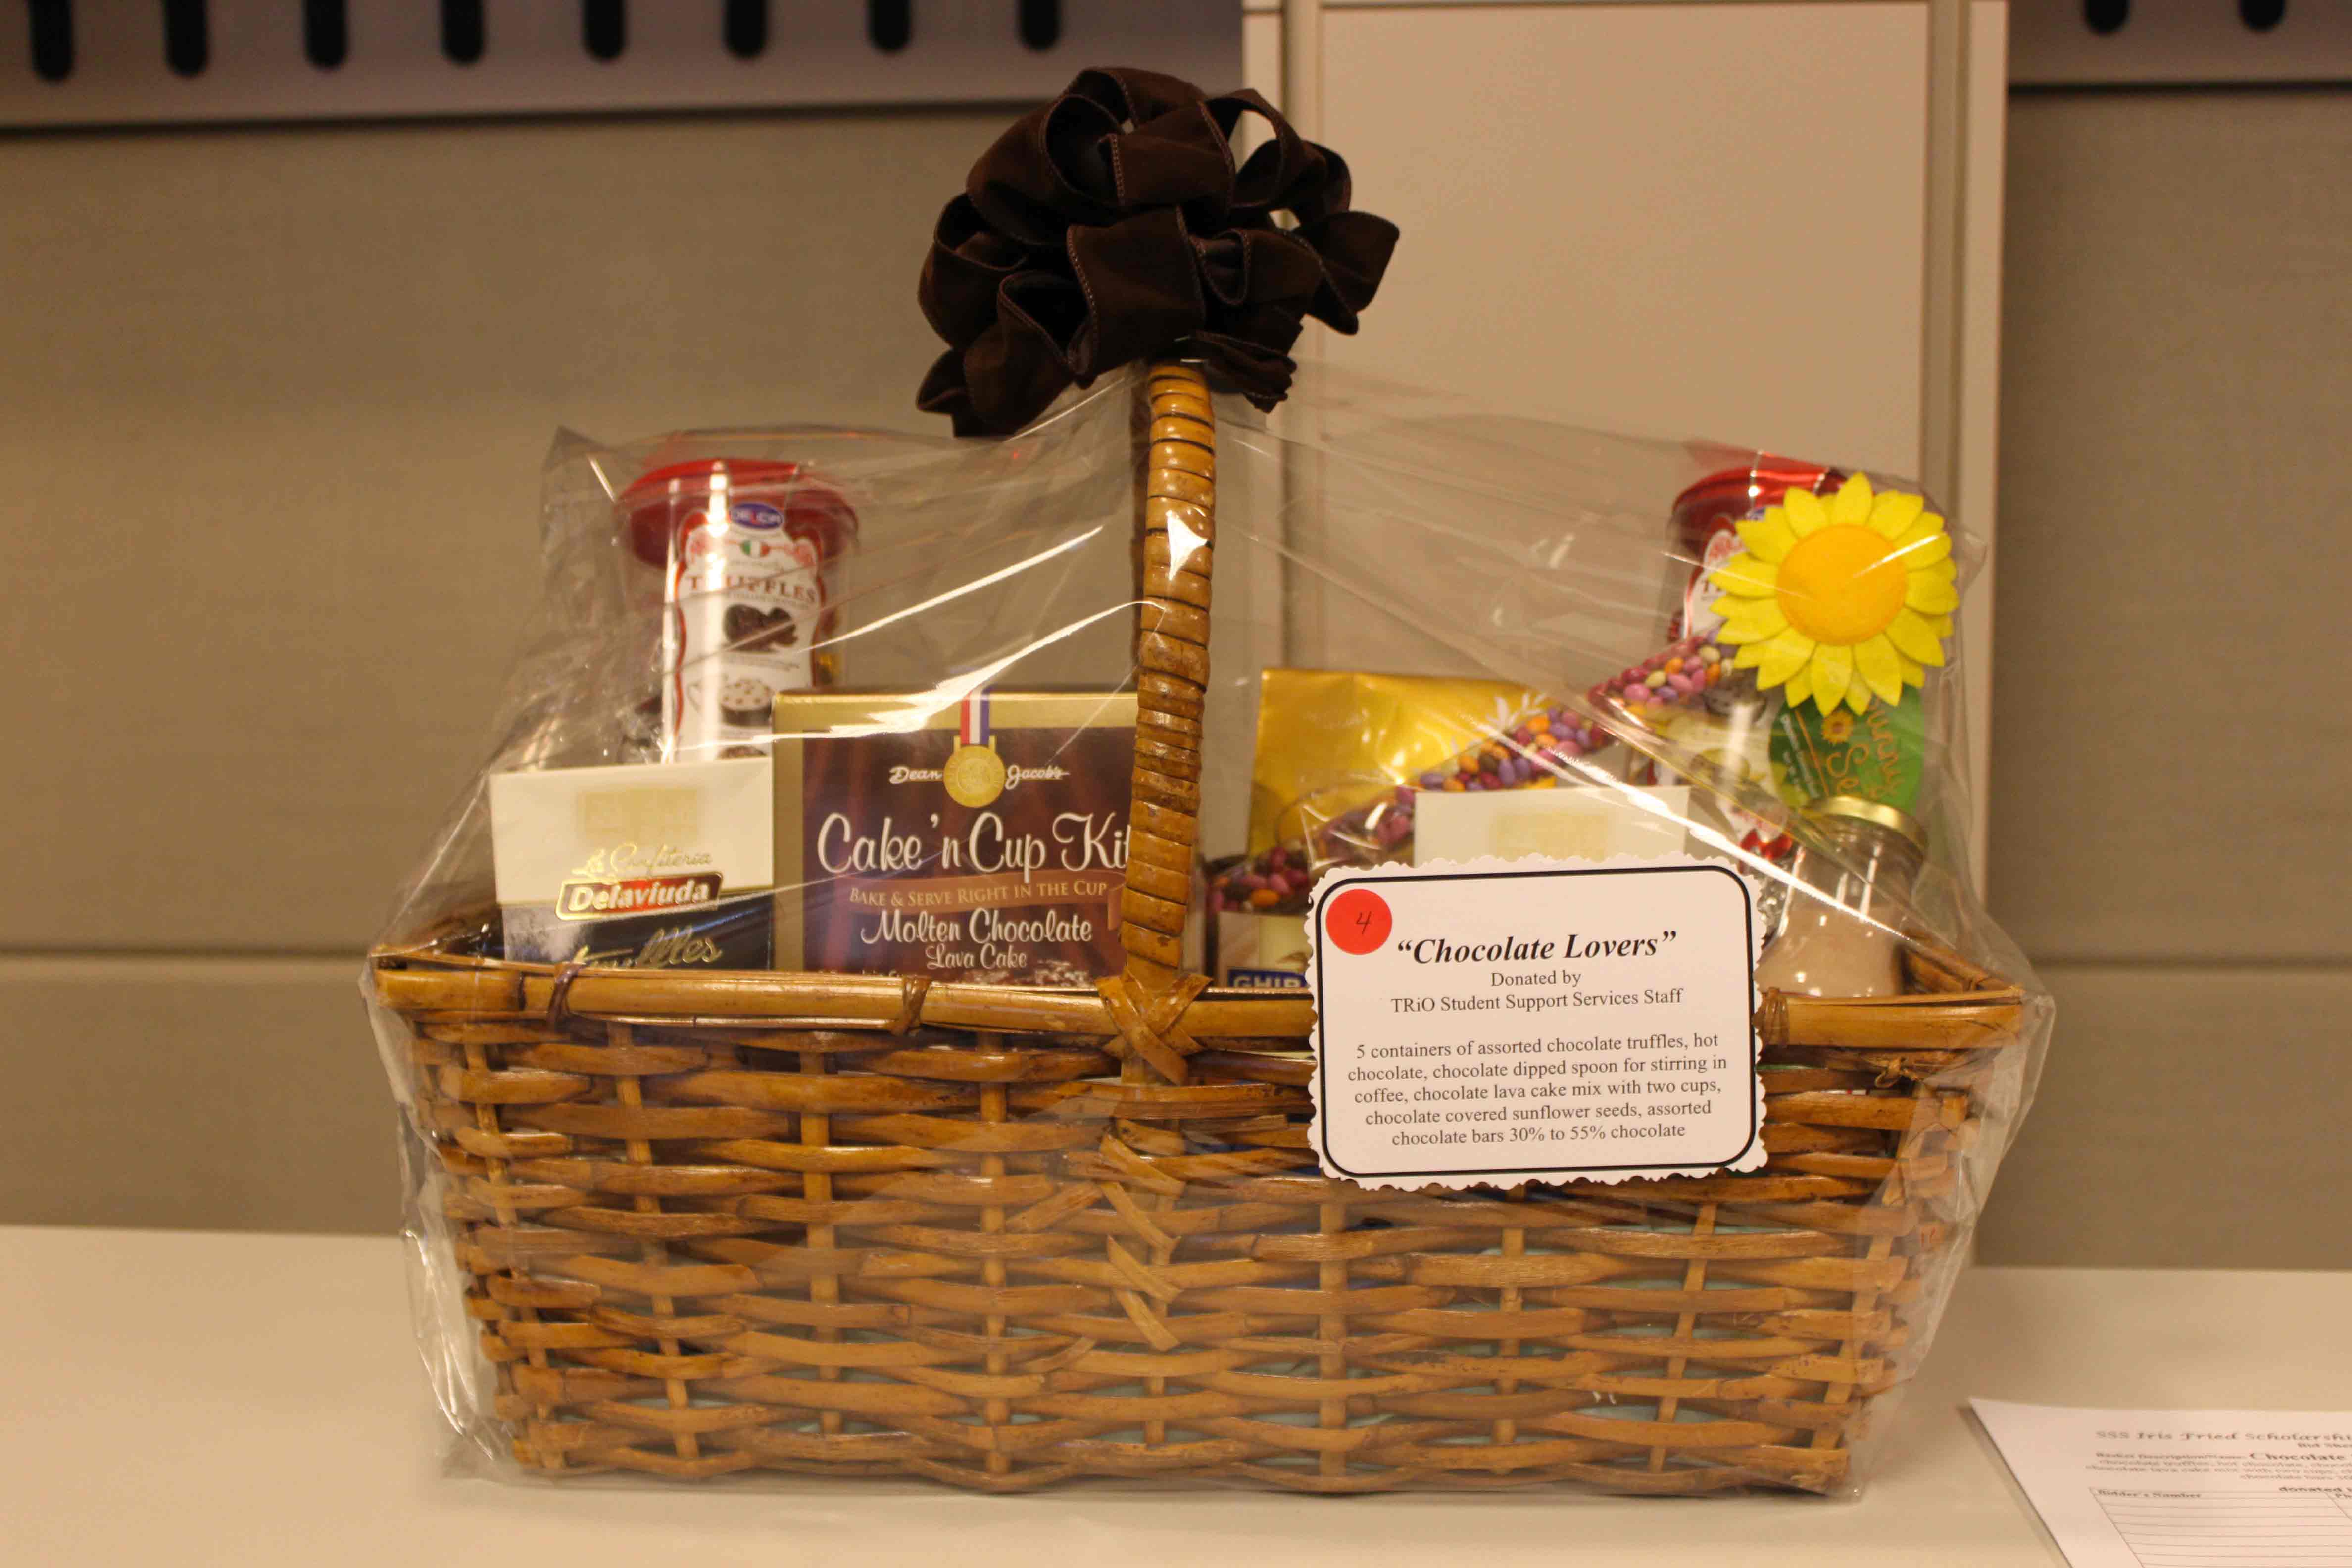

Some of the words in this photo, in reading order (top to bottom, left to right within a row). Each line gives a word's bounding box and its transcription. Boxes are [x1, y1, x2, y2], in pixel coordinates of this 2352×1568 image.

[687, 575, 816, 603] TUFFLES
[888, 766, 943, 784] Dean
[817, 811, 923, 874] Cake
[969, 811, 1047, 884] Cup
[568, 879, 710, 911] Delaviuda
[850, 887, 886, 906] BAKE
[890, 891, 904, 907] &
[907, 891, 952, 906] SERVE
[958, 886, 1009, 904] RIGHT
[1014, 884, 1032, 898] IN
[1037, 882, 1069, 897] THE
[1073, 879, 1107, 896] CUP
[860, 909, 961, 945] Molten
[968, 907, 1092, 944] Chocolate
[1356, 910, 1372, 935] 4
[925, 944, 974, 970] Lava
[980, 943, 1028, 970] Cake
[1397, 935, 1555, 965] “Chocolate
[1563, 930, 1677, 959] Lovers”
[1233, 975, 1302, 989] GHIR
[1491, 969, 1557, 987] Donated
[1562, 969, 1581, 988] by
[1390, 997, 1436, 1013] TRiO
[1440, 995, 1500, 1011] Student
[1505, 993, 1568, 1013] Support
[1572, 991, 1639, 1007] Services
[1644, 987, 1684, 1004] Staff
[1357, 1044, 1365, 1059] 5
[1370, 1043, 1452, 1059] containers
[1456, 1040, 1475, 1056] of
[1477, 1038, 1542, 1055] assorted
[1547, 1036, 1622, 1053] chocolate
[1627, 1033, 1689, 1050] truffles,
[1694, 1032, 1718, 1048] hot
[1348, 1065, 1428, 1083] chocolate,
[1432, 1062, 1508, 1079] chocolate
[1513, 1059, 1566, 1080] dipped
[1571, 1060, 1618, 1078] spoon
[1623, 1056, 1646, 1073] for
[1650, 1055, 1707, 1075] stirring
[1713, 1054, 1727, 1069] in
[1354, 1087, 1408, 1105] coffee,
[1413, 1085, 1488, 1102] chocolate
[1493, 1084, 1526, 1099] lava
[1530, 1082, 1567, 1098] cake
[1571, 1081, 1602, 1096] mix
[1607, 1079, 1641, 1095] with
[1647, 1080, 1676, 1094] two
[1680, 1080, 1722, 1098] cups,
[1365, 1109, 1441, 1126] chocolate
[1445, 1106, 1507, 1123] covered
[1512, 1103, 1591, 1120] sunflower
[1595, 1102, 1643, 1118] seeds,
[1647, 1099, 1711, 1116] assorted
[1392, 1129, 1467, 1146] chocolate
[1471, 1128, 1504, 1144] bars
[1509, 1127, 1545, 1142] 30%
[1549, 1127, 1565, 1141] to
[1570, 1124, 1607, 1140] 55%
[1611, 1123, 1685, 1139] chocolate
[2245, 1433, 2352, 1441] Scholarshi
[2249, 1452, 2345, 1461] Chocolate
